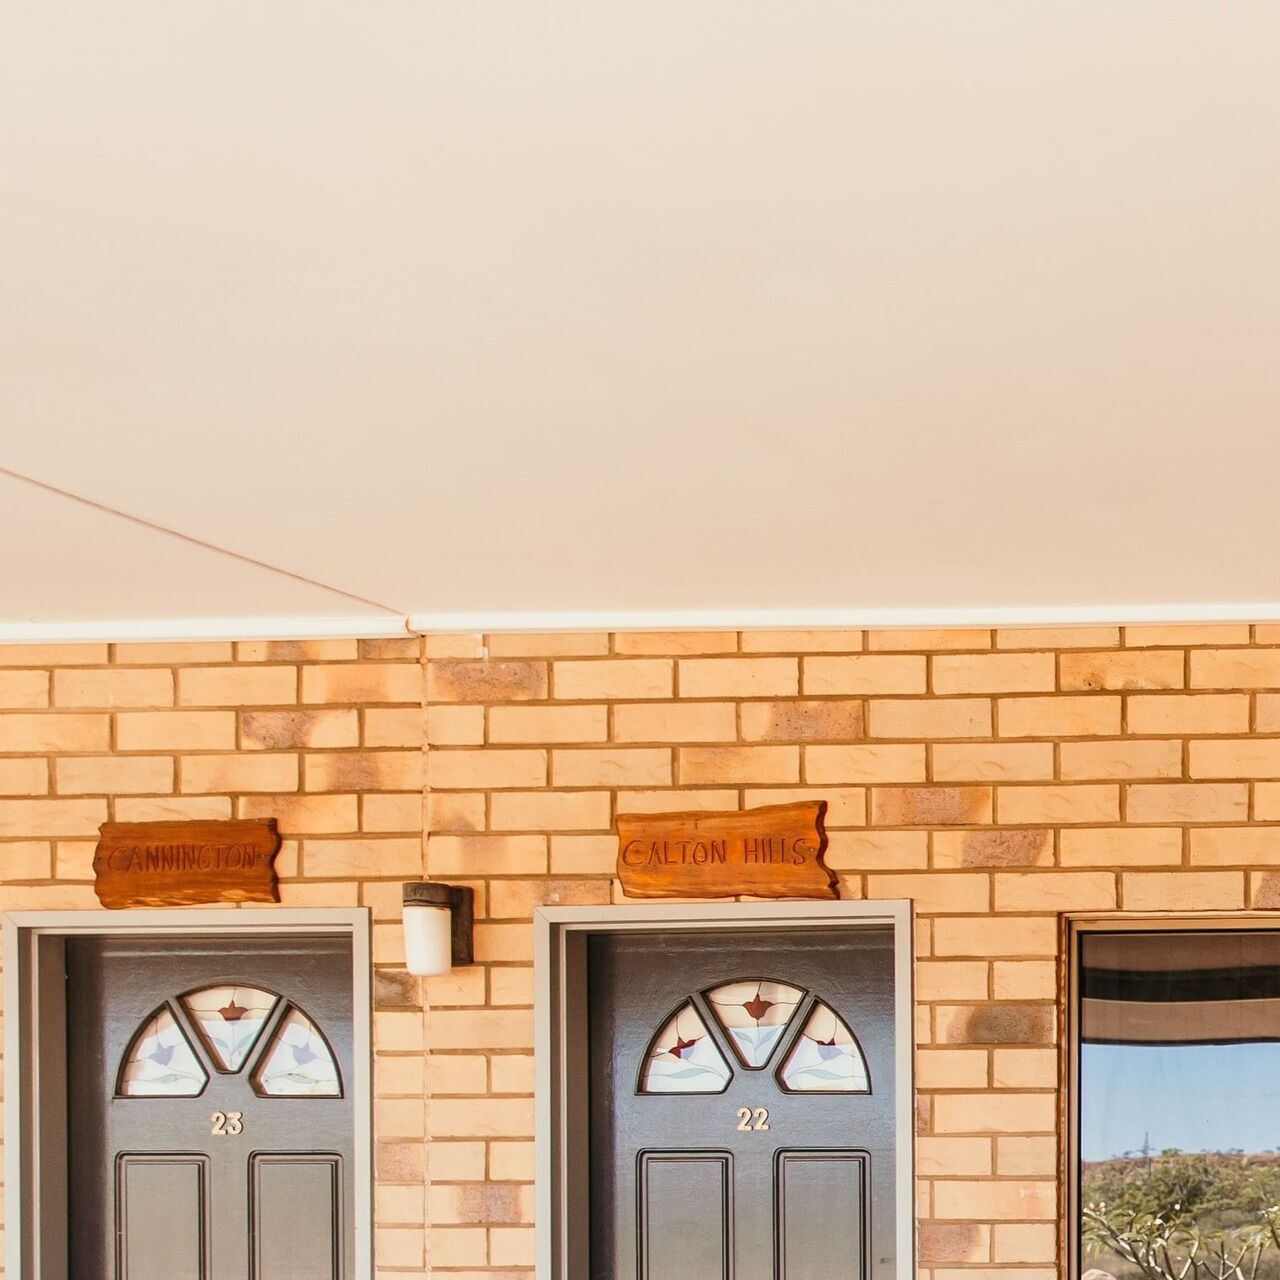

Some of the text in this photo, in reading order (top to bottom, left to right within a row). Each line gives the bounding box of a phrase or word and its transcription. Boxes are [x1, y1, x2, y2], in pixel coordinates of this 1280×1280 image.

[107, 842, 258, 873] CANNINGTON
[621, 837, 807, 867] CALTON HILLS
[211, 1111, 244, 1135] 23
[737, 1106, 771, 1131] 22
